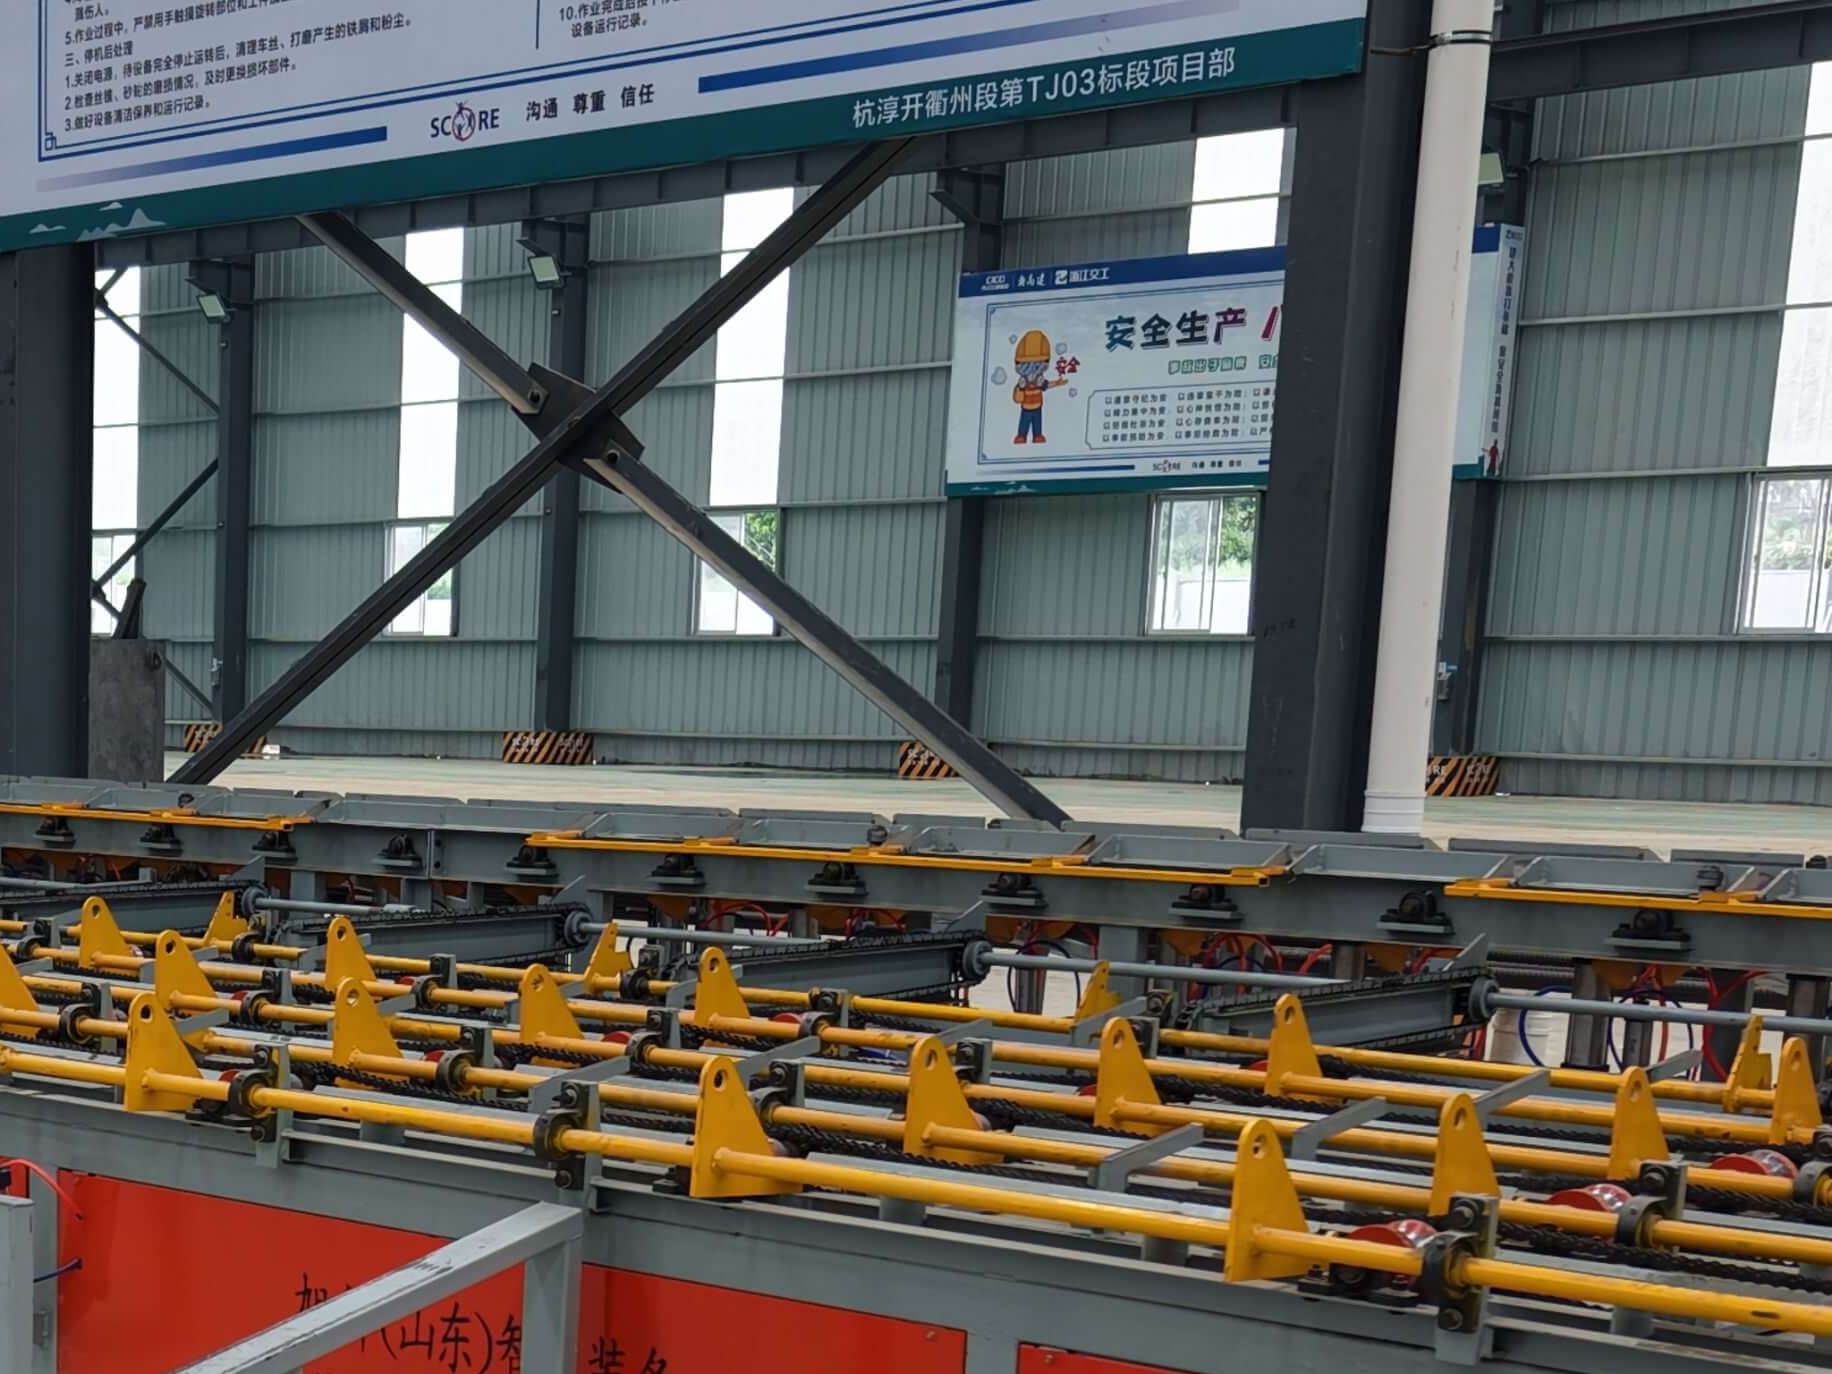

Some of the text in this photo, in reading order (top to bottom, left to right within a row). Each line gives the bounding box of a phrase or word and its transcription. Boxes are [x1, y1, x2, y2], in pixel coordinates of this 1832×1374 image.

[64, 41, 134, 67] 三、停机后处理
[525, 84, 655, 121] 沟通 尊重 信任
[852, 46, 1237, 128] 杭淳开衢州段第TJ03标段项目部
[1105, 306, 1248, 352] 安全生产
[1056, 356, 1080, 376] 安全
